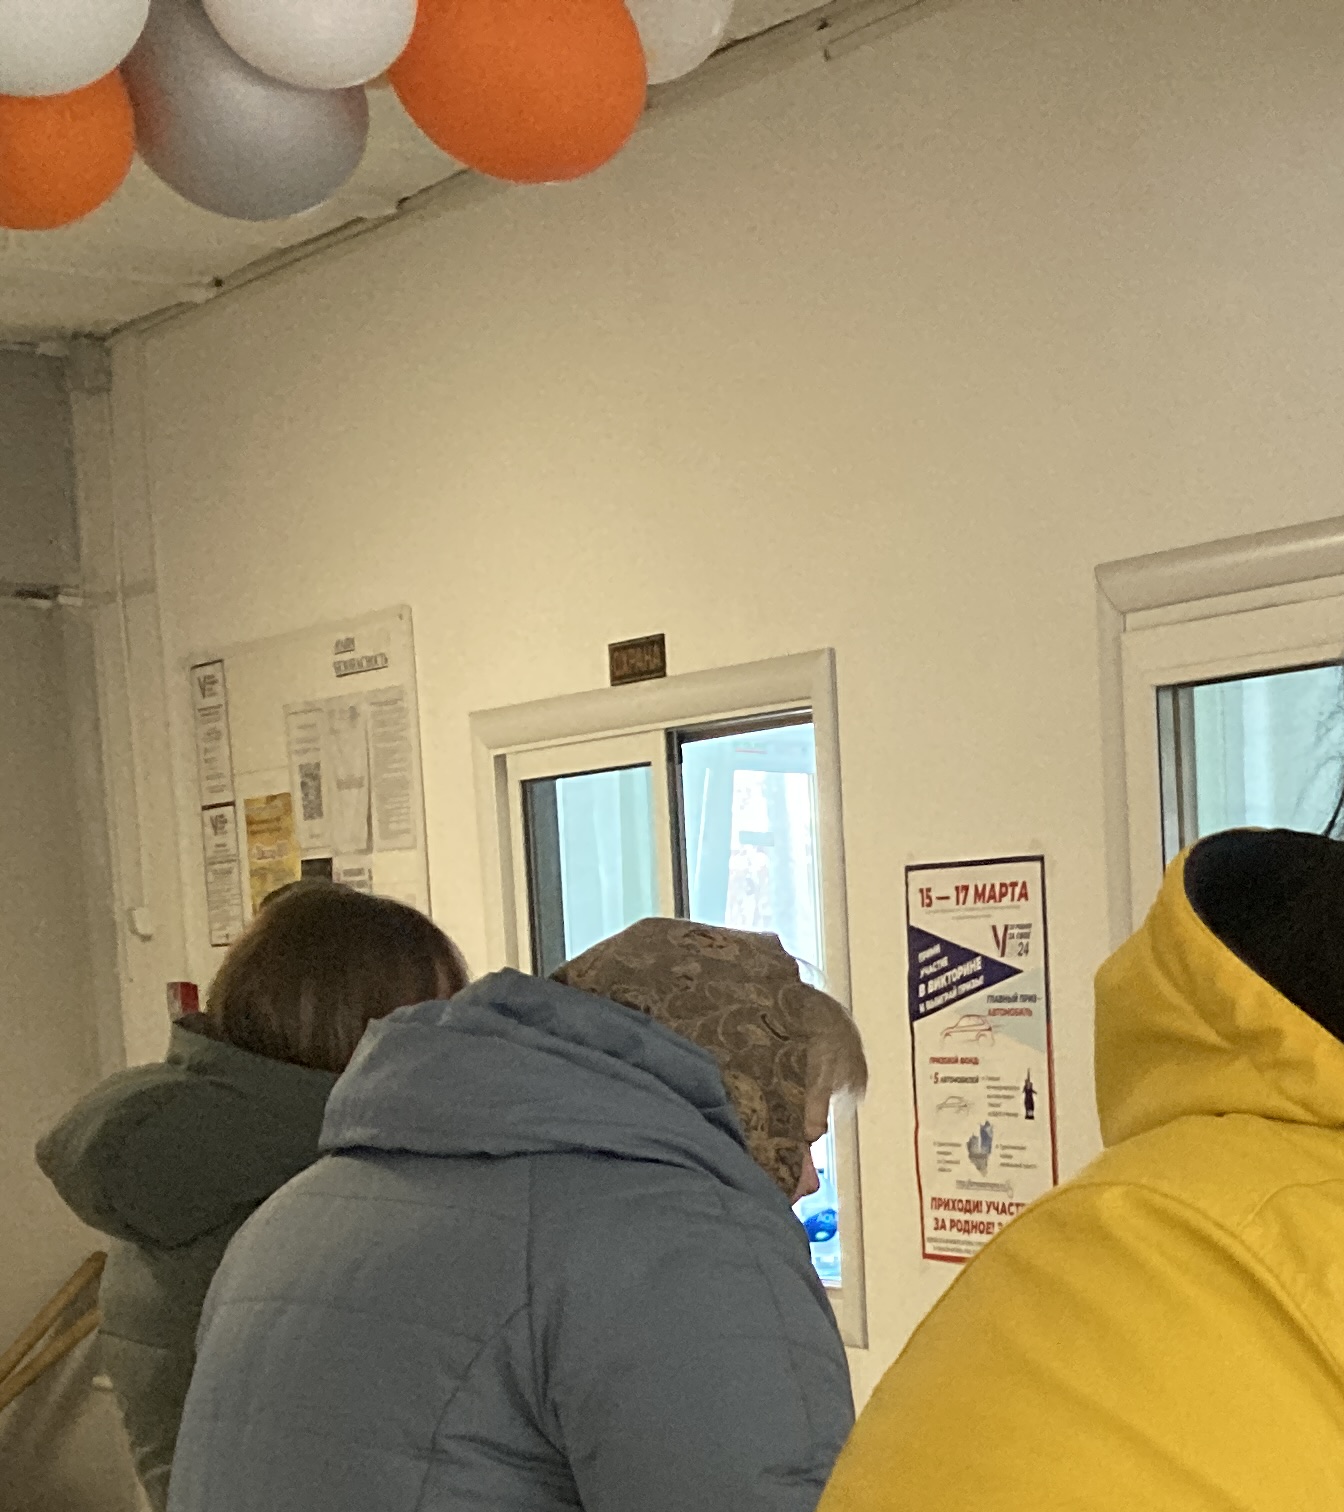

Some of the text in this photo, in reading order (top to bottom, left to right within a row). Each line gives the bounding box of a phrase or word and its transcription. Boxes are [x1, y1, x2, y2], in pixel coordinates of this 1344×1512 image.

[919, 887, 933, 908] 15
[955, 884, 969, 906] 17
[973, 880, 1029, 904] МАРТА
[1017, 941, 1029, 957] 24
[927, 955, 982, 994] ВИКТОРИНЕ
[933, 1072, 939, 1084] 5
[930, 1197, 983, 1215] ПРИХОДИ!
[933, 1217, 947, 1231] ЗА
[949, 1218, 995, 1236] РОДНОЕ!
